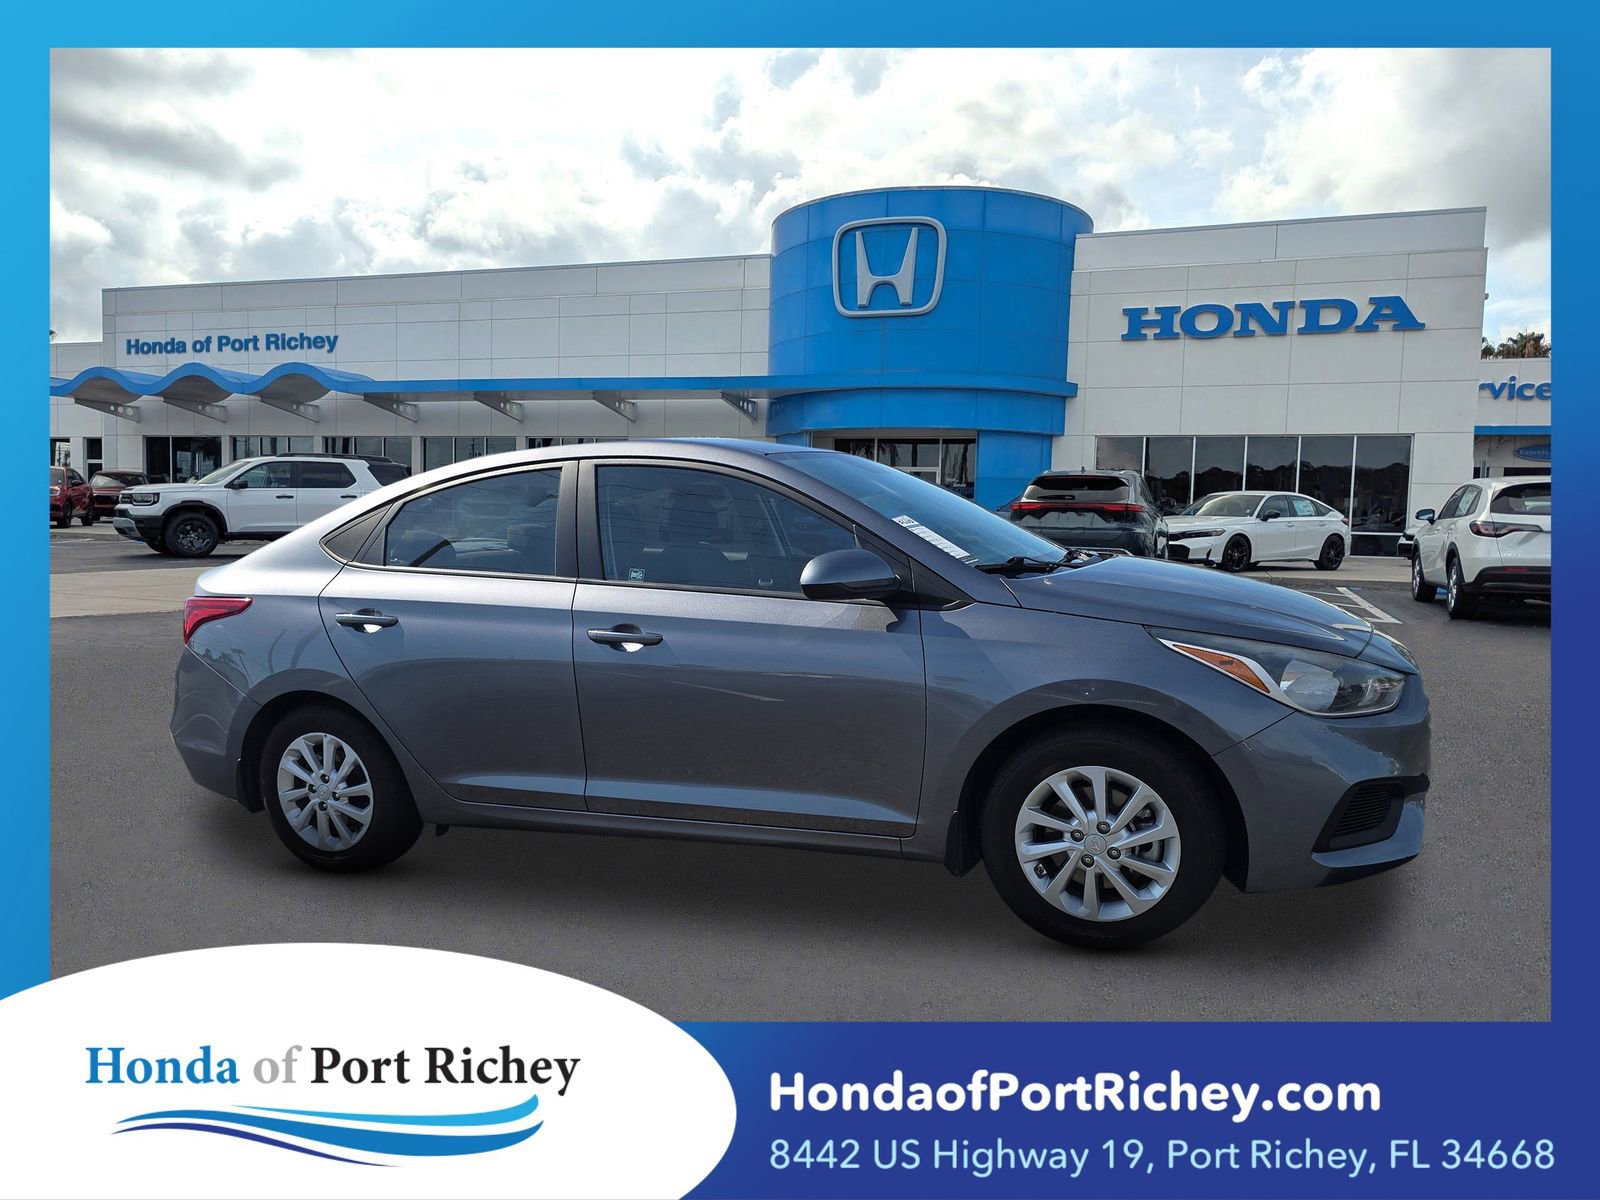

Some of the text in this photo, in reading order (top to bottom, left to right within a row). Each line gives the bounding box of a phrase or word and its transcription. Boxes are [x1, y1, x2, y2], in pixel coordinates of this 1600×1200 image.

[1121, 295, 1426, 341] HONDA
[125, 333, 339, 355] Honda of Port Richey
